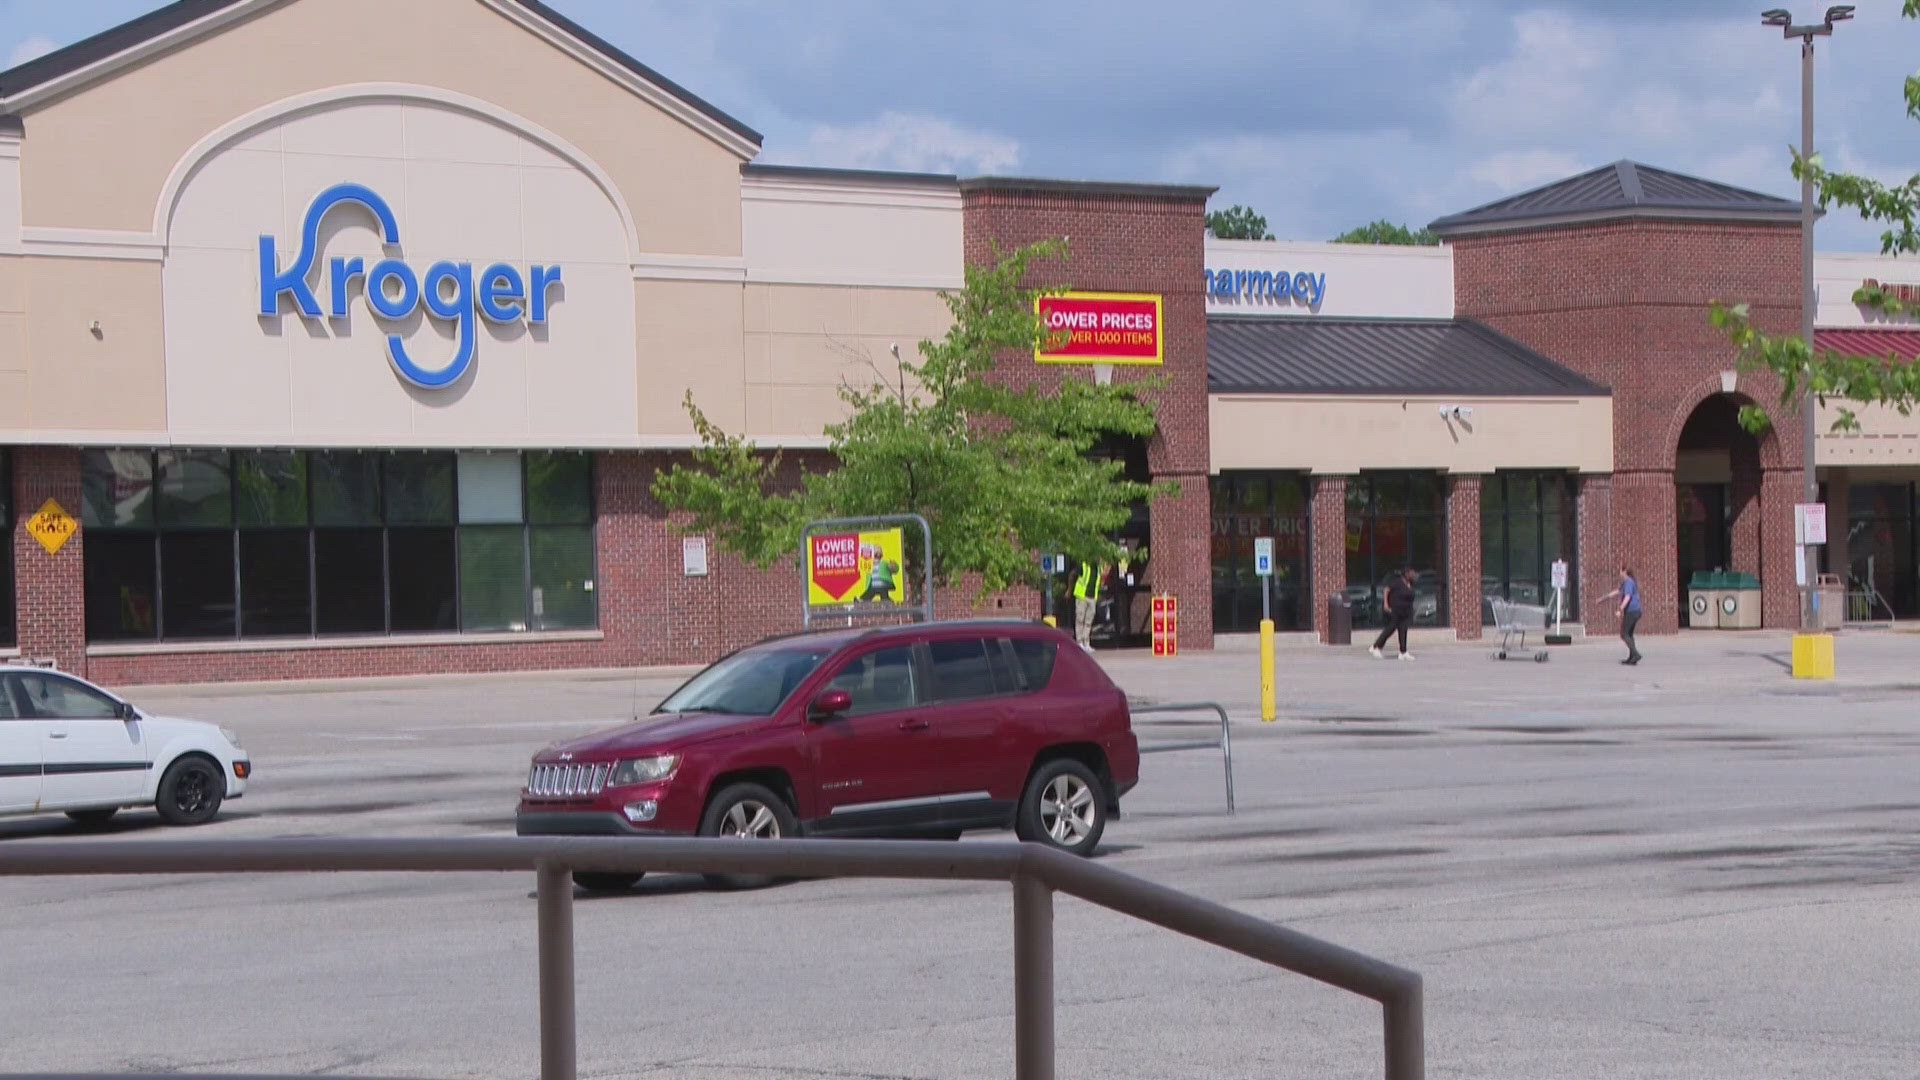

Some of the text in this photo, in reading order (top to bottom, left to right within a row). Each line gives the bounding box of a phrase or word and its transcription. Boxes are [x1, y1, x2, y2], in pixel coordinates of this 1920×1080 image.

[259, 182, 561, 387] Kroger
[1101, 312, 1153, 330] PRICES
[1062, 331, 1092, 344] VER
[1094, 332, 1121, 345] 1,000
[1123, 333, 1153, 346] ITEMS
[40, 513, 63, 523] SAFE
[35, 523, 68, 534] PLACE
[815, 538, 855, 554] LOWER
[816, 553, 856, 569] PRICES
